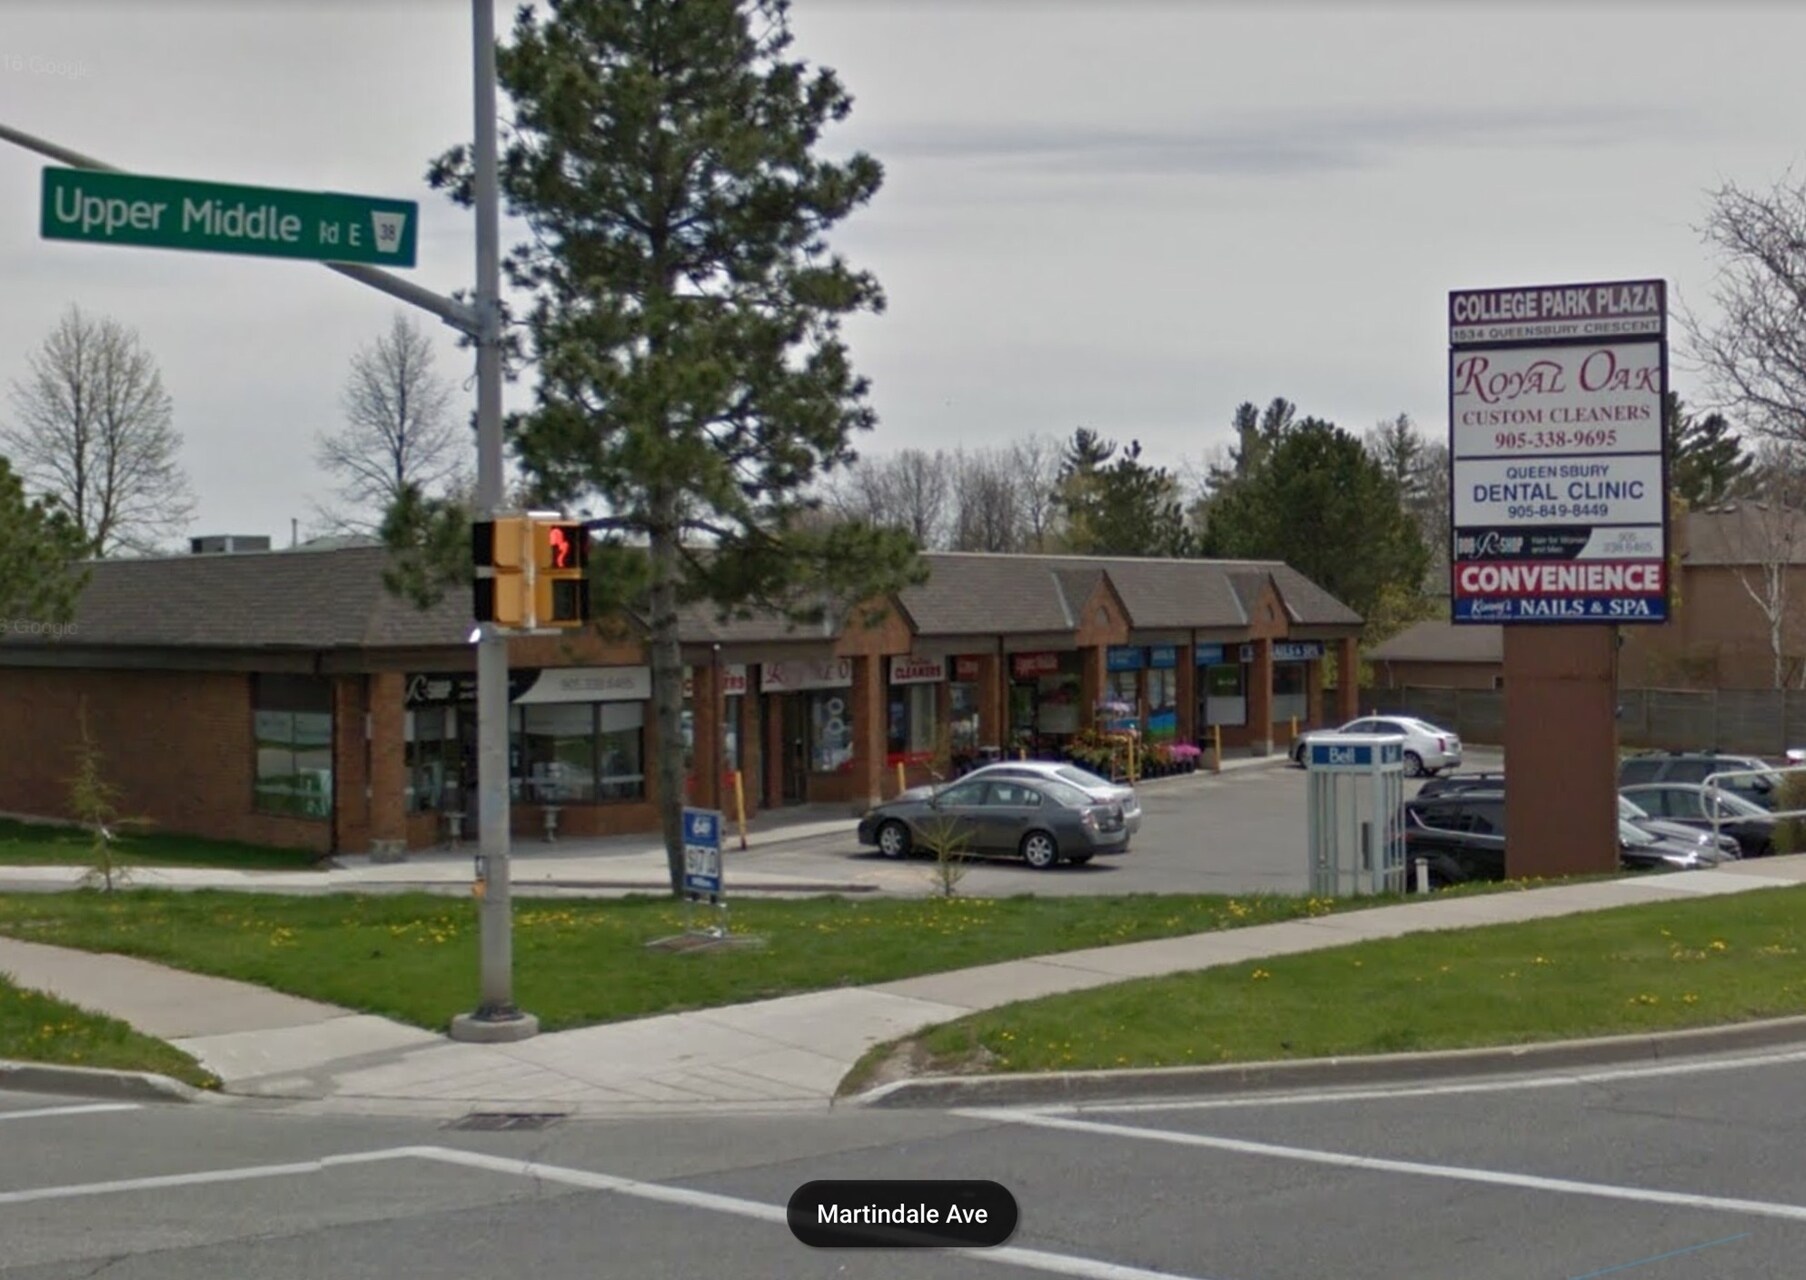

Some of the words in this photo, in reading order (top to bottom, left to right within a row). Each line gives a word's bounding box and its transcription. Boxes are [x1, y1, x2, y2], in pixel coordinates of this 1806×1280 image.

[55, 186, 167, 235] Upper
[181, 198, 301, 242] Middle
[349, 222, 362, 247] E
[1454, 291, 1537, 321] COLLEGE
[1542, 288, 1591, 317] PARK
[1598, 285, 1659, 314] PLAZA
[1454, 328, 1485, 340] 1534
[1489, 324, 1579, 339] QUEENSBURY
[1584, 319, 1660, 333] CRESCENT
[1462, 409, 1543, 426] CUSTOM
[1550, 405, 1650, 424] CLEANERS
[1495, 430, 1617, 449] 905-338-9695
[1473, 483, 1558, 503] DENTAL
[1568, 480, 1644, 501] CLINIC
[1508, 504, 1609, 519] 905-849-8449
[1460, 565, 1661, 592] CONVENIENCE
[1520, 599, 1585, 616] NAILS
[1609, 599, 1650, 615] SPA
[1329, 746, 1355, 763] Bell
